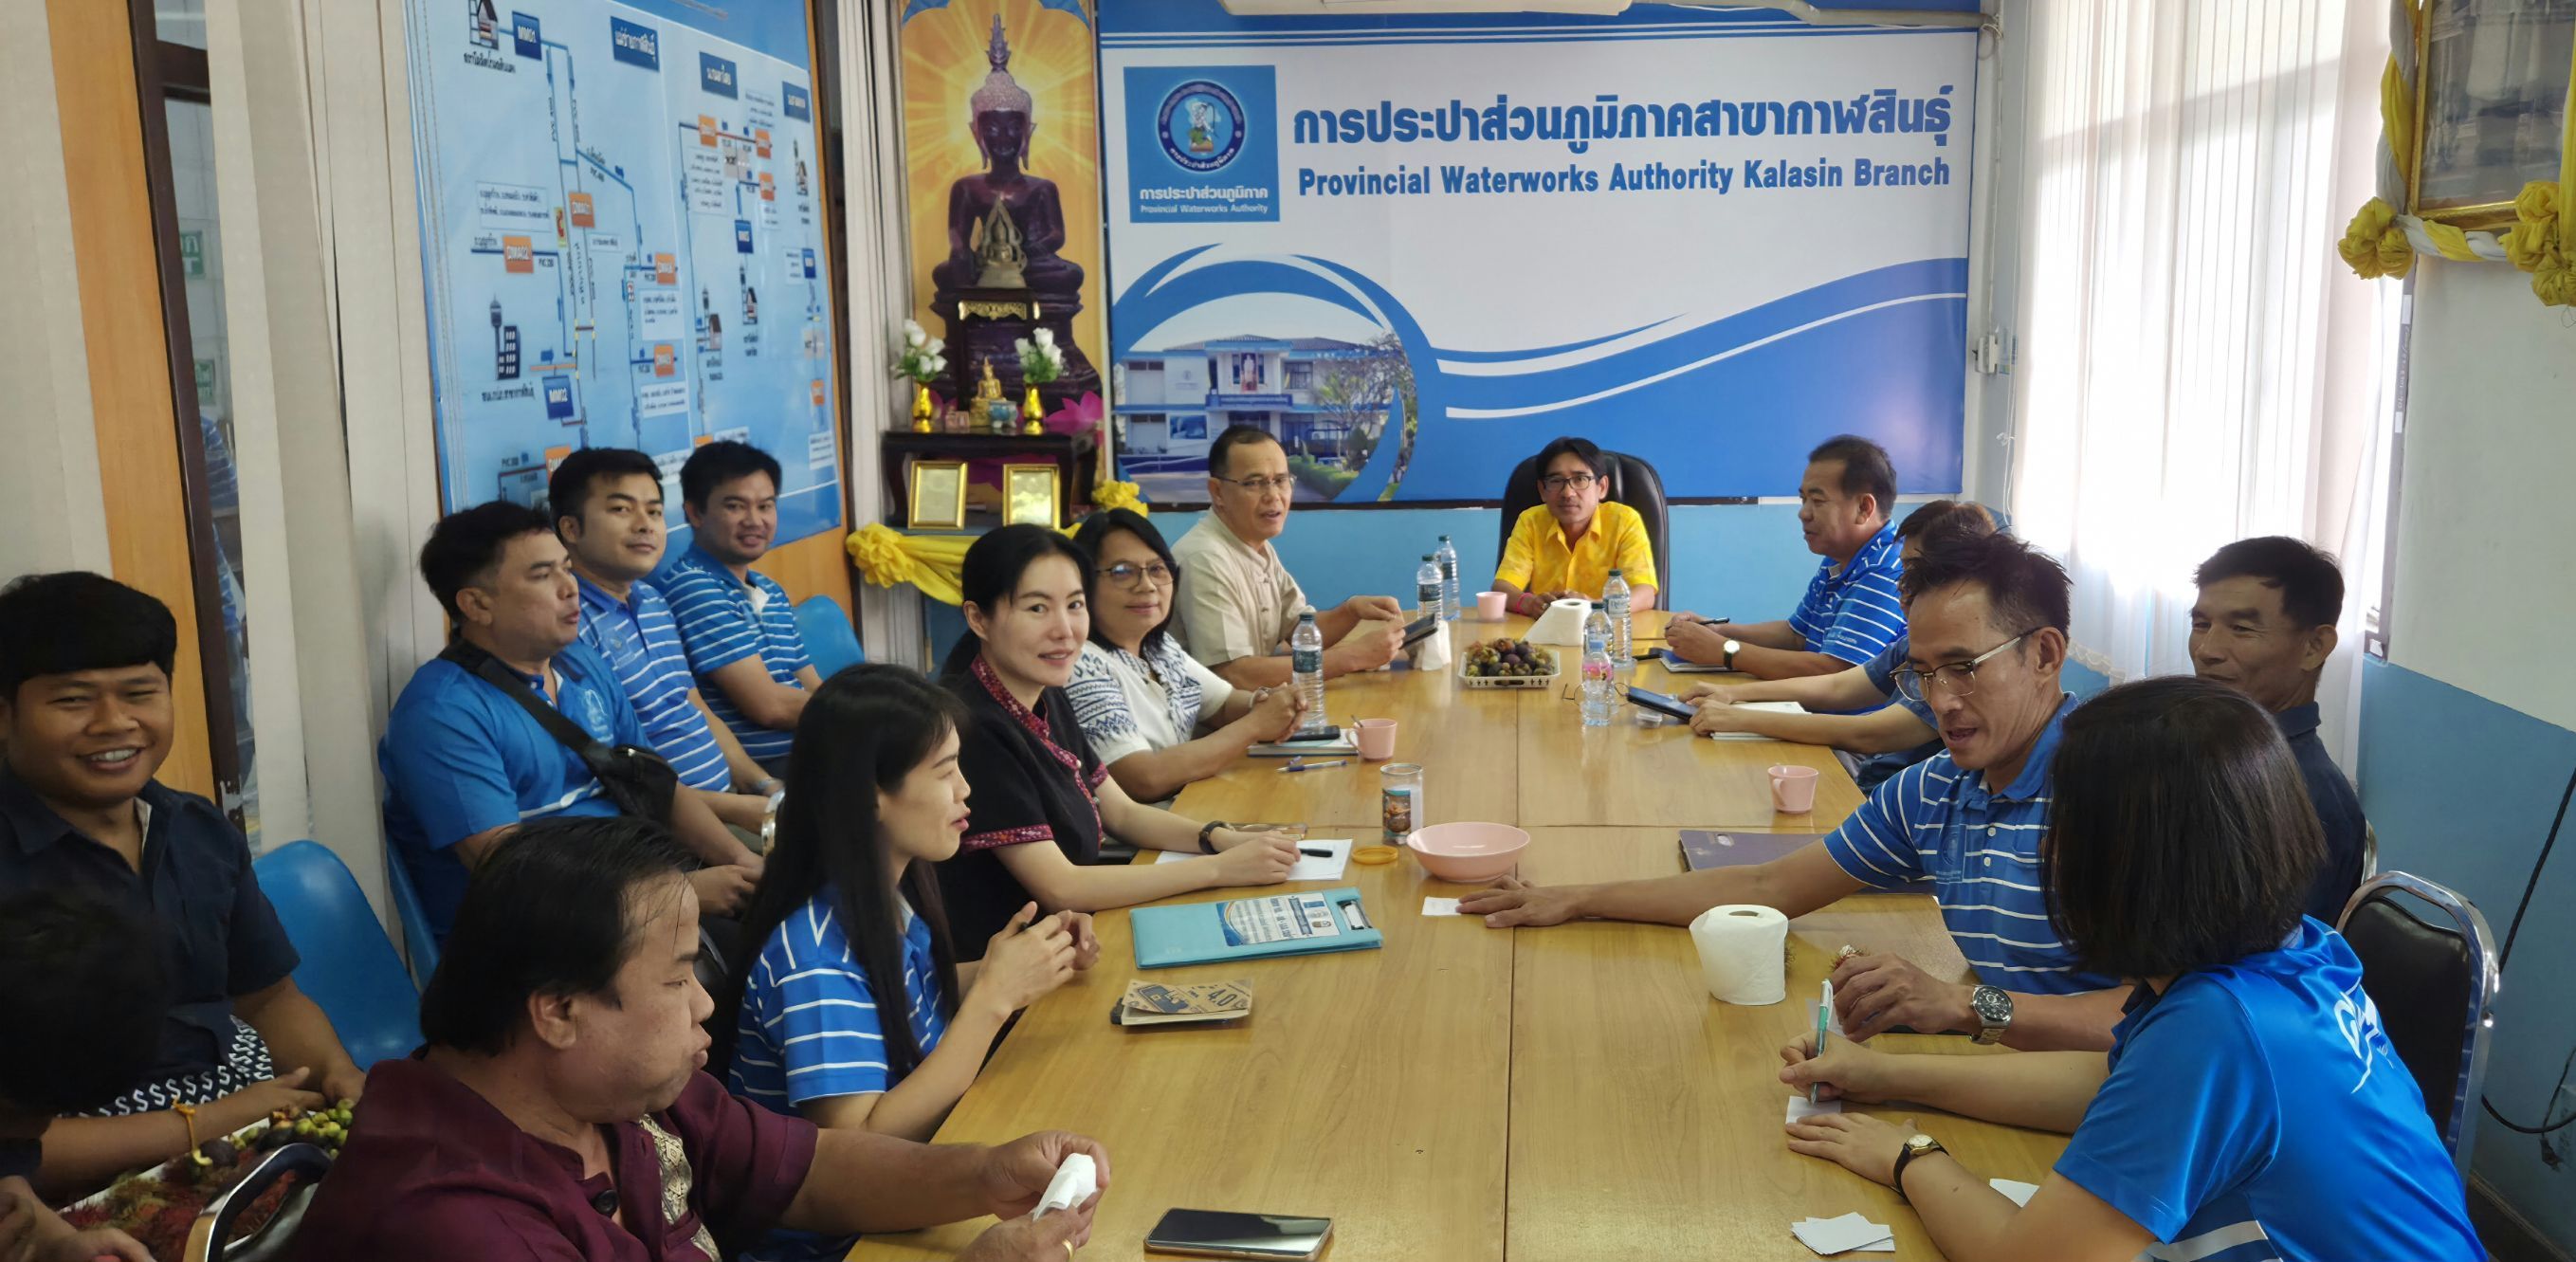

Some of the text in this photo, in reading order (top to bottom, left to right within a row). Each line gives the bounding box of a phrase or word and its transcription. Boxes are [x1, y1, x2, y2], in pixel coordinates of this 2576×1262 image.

[1294, 84, 1954, 154] การประปาส่วนภูมิภาคสาขากาฬสินธุ์
[1299, 157, 1950, 196] Provincial Waterworks Authority Kalasin Branch
[1140, 185, 1269, 203] การประปาส่วนภูมิภาค
[1141, 204, 1269, 214] Provincial Waterworks Authority
